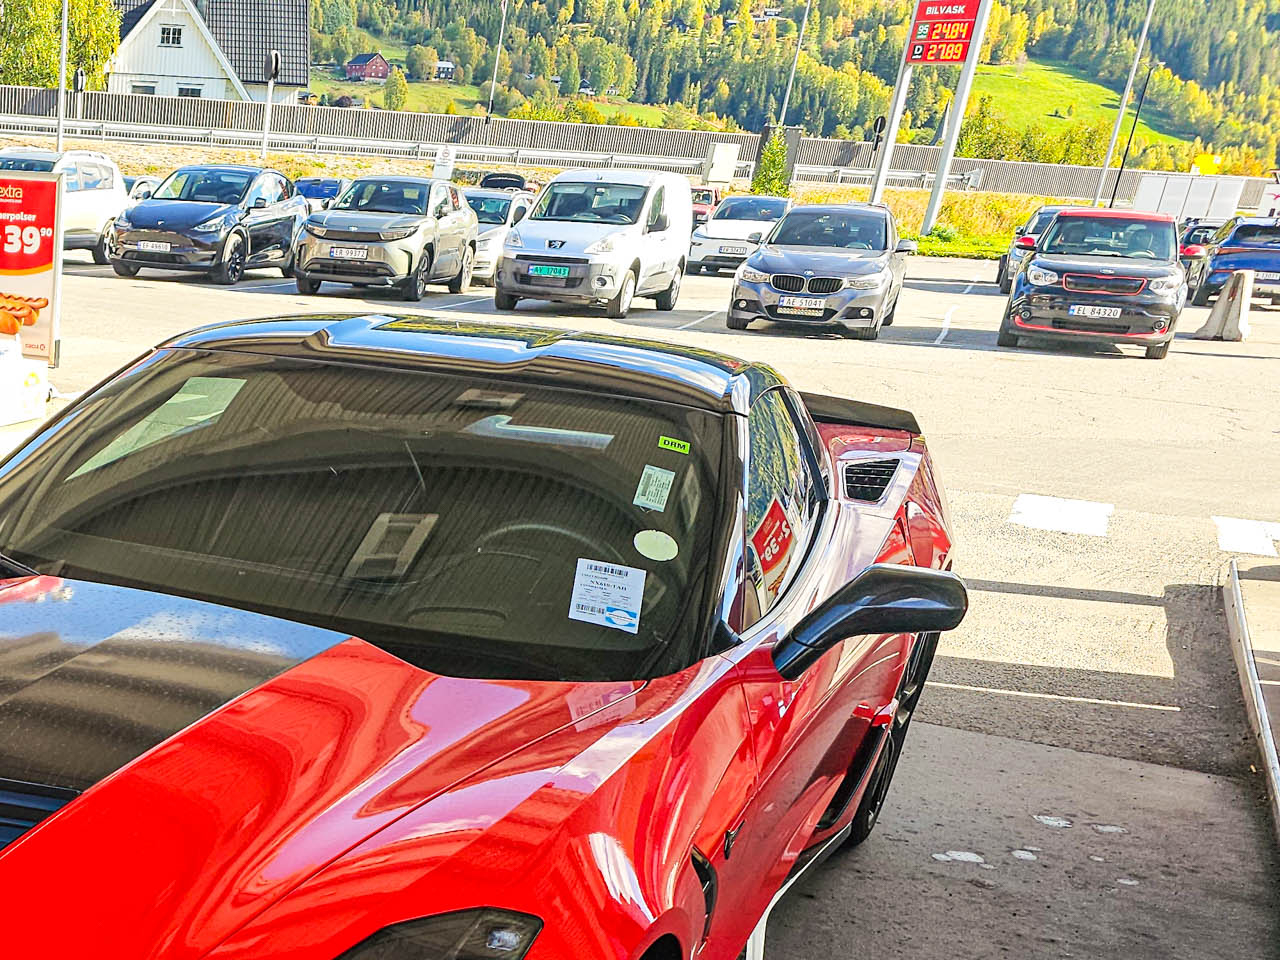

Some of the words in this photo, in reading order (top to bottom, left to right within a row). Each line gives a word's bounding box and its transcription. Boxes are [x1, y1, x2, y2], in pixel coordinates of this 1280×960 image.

[925, 5, 966, 15] BILVASK
[918, 25, 929, 34] 95
[914, 45, 923, 55] D
[786, 298, 796, 306] AE
[799, 299, 822, 307] 51041
[1076, 306, 1086, 314] EL
[1090, 307, 1119, 316] 84320
